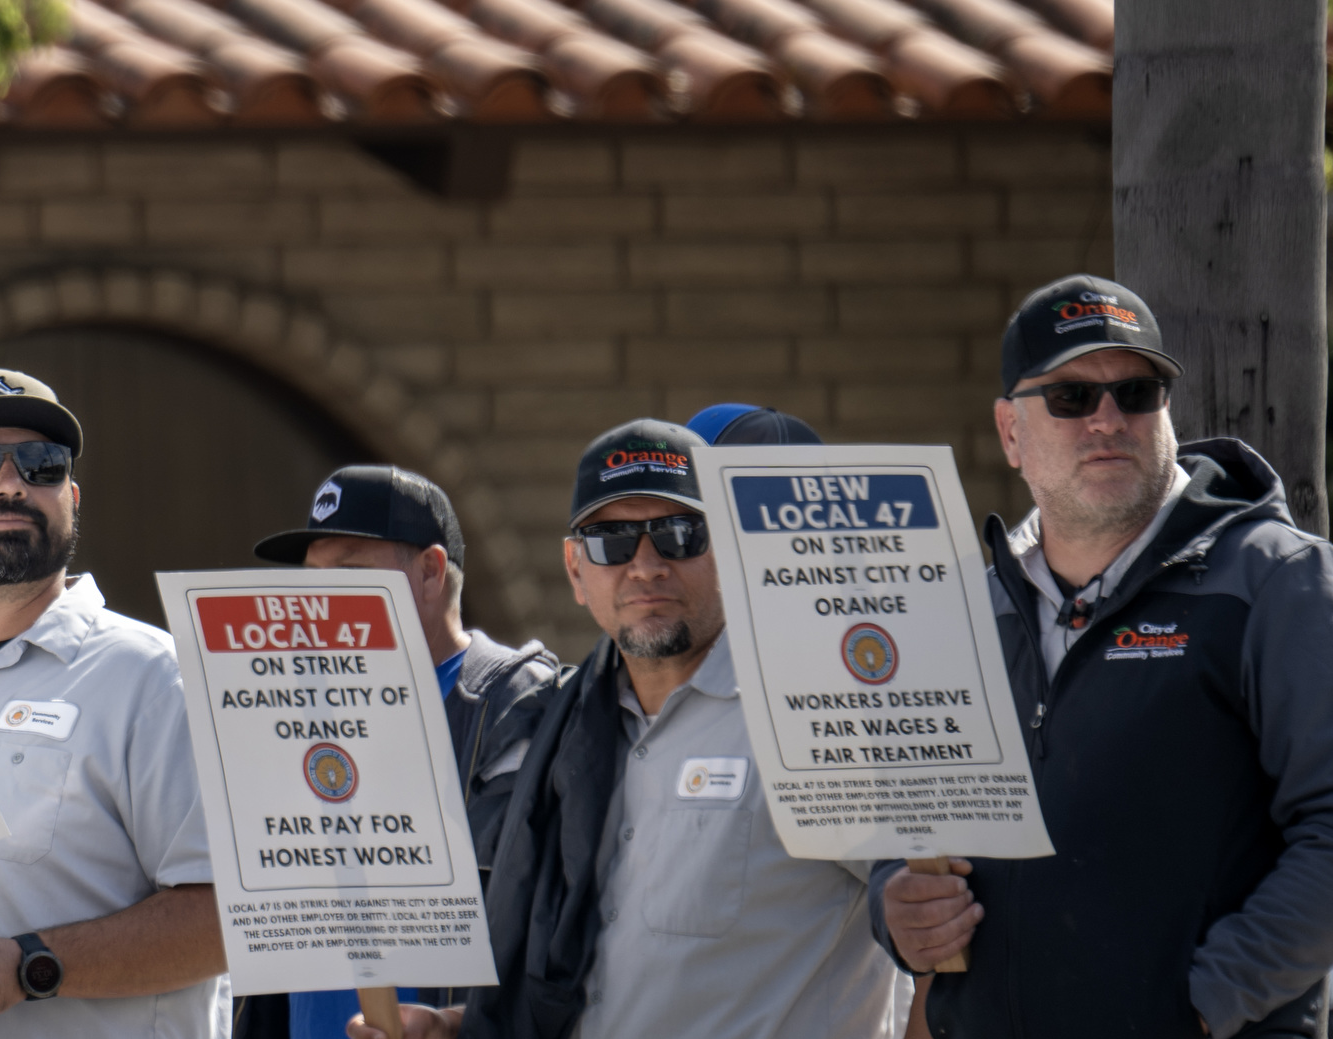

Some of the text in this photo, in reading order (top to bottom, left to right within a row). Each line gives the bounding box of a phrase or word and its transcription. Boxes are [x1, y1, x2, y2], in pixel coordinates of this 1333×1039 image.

[1060, 302, 1137, 322] Orange
[1055, 318, 1141, 334] Community Services
[627, 440, 667, 450] City of
[606, 450, 688, 468] Orange
[600, 465, 687, 482] Community Services
[790, 476, 868, 501] IBEW
[759, 502, 912, 530] LOCAL 47
[790, 535, 905, 555] ON STRIKE
[763, 564, 946, 586] AGAINST CITY OF
[255, 596, 329, 621] IBEW
[814, 595, 907, 616] ORANGE
[225, 623, 371, 649] LOCAL 47
[1139, 623, 1178, 635] City of
[1116, 630, 1189, 649] Orange
[1105, 648, 1185, 660] Community Services
[251, 655, 367, 676] ON STRIKE
[222, 686, 409, 708] AGAINST CITY OF
[785, 689, 972, 710] WORKERS DESERVE
[32, 711, 61, 720] Community
[32, 718, 54, 726] Services
[275, 719, 368, 739] ORANGE
[811, 717, 961, 737] FAIR WAGES &
[811, 743, 972, 764] FAIR TREATMENT
[264, 814, 415, 835] FAIR PAY FOR
[259, 845, 432, 868] HONEST WORK!
